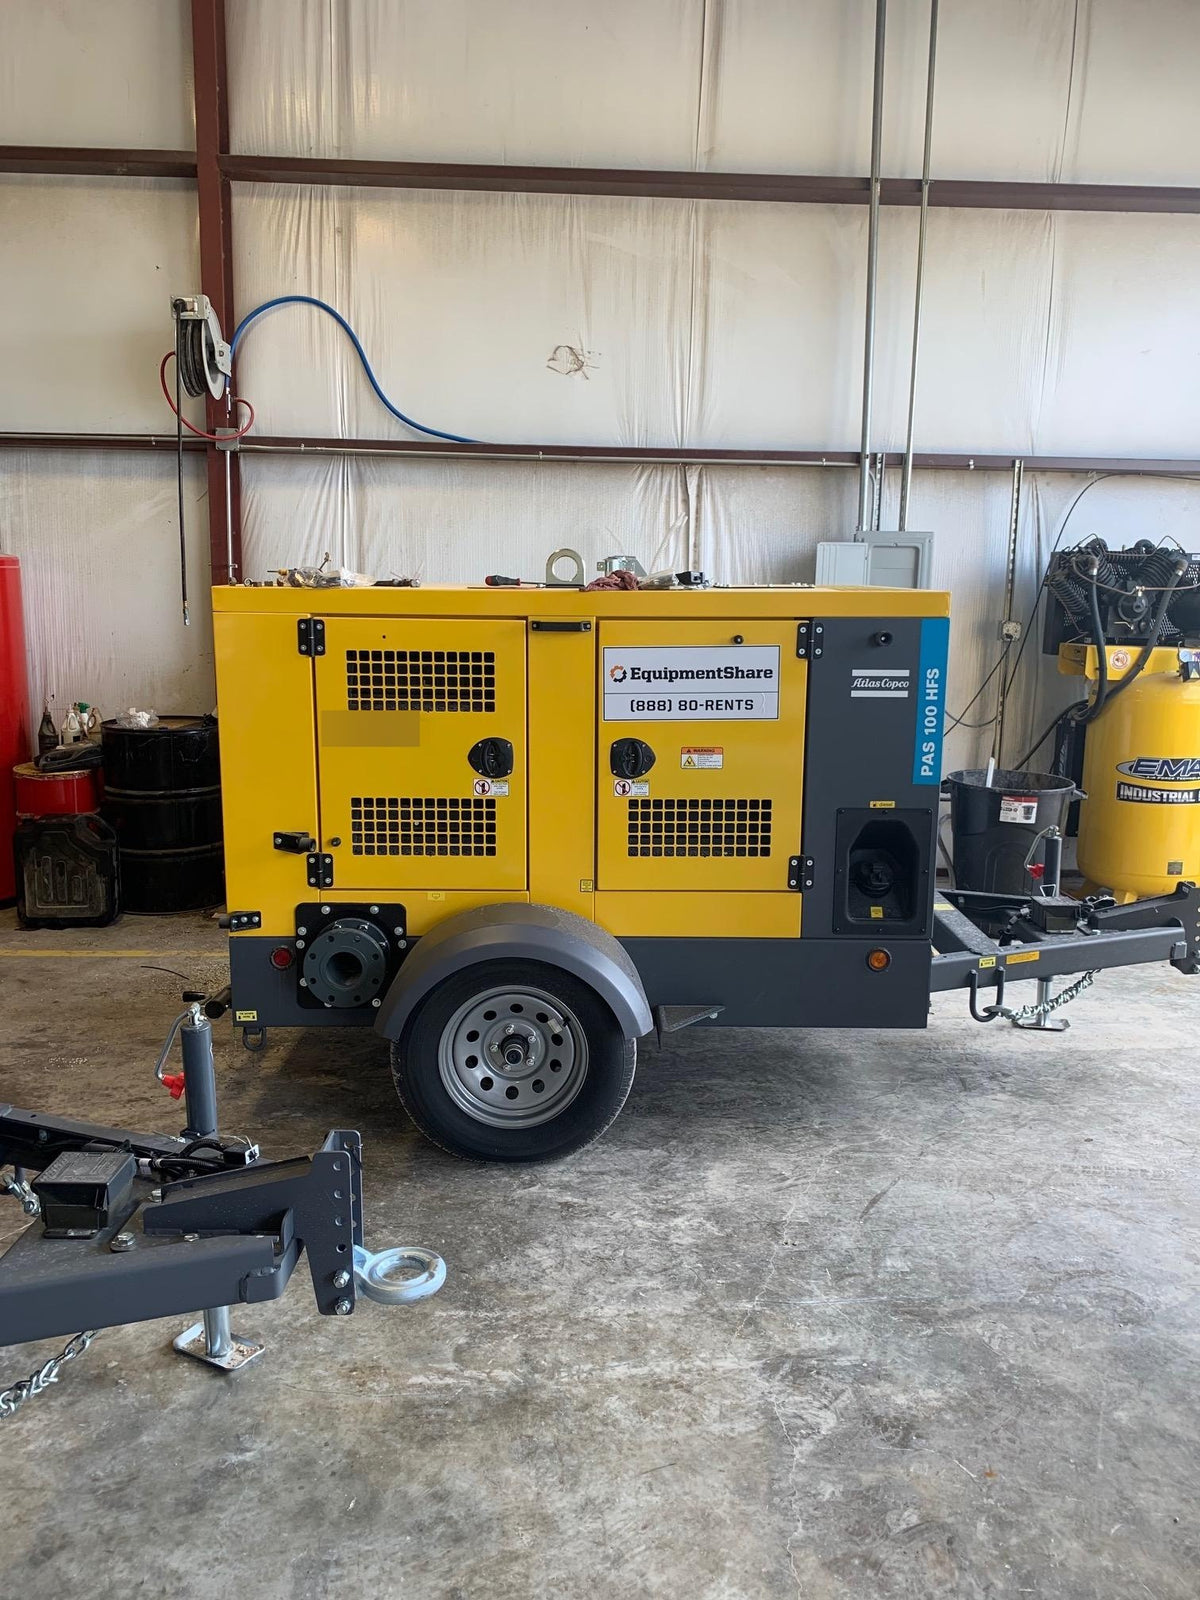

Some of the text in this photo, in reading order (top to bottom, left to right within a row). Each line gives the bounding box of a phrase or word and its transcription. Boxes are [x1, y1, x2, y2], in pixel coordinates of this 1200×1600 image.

[630, 666, 773, 683] EquipmentShare
[851, 677, 909, 689] Atlas Copco
[630, 699, 754, 712] (888) 80-RENTS
[920, 668, 940, 776] PAS 100 HFS
[1120, 784, 1196, 802] INDUSTRIAL
